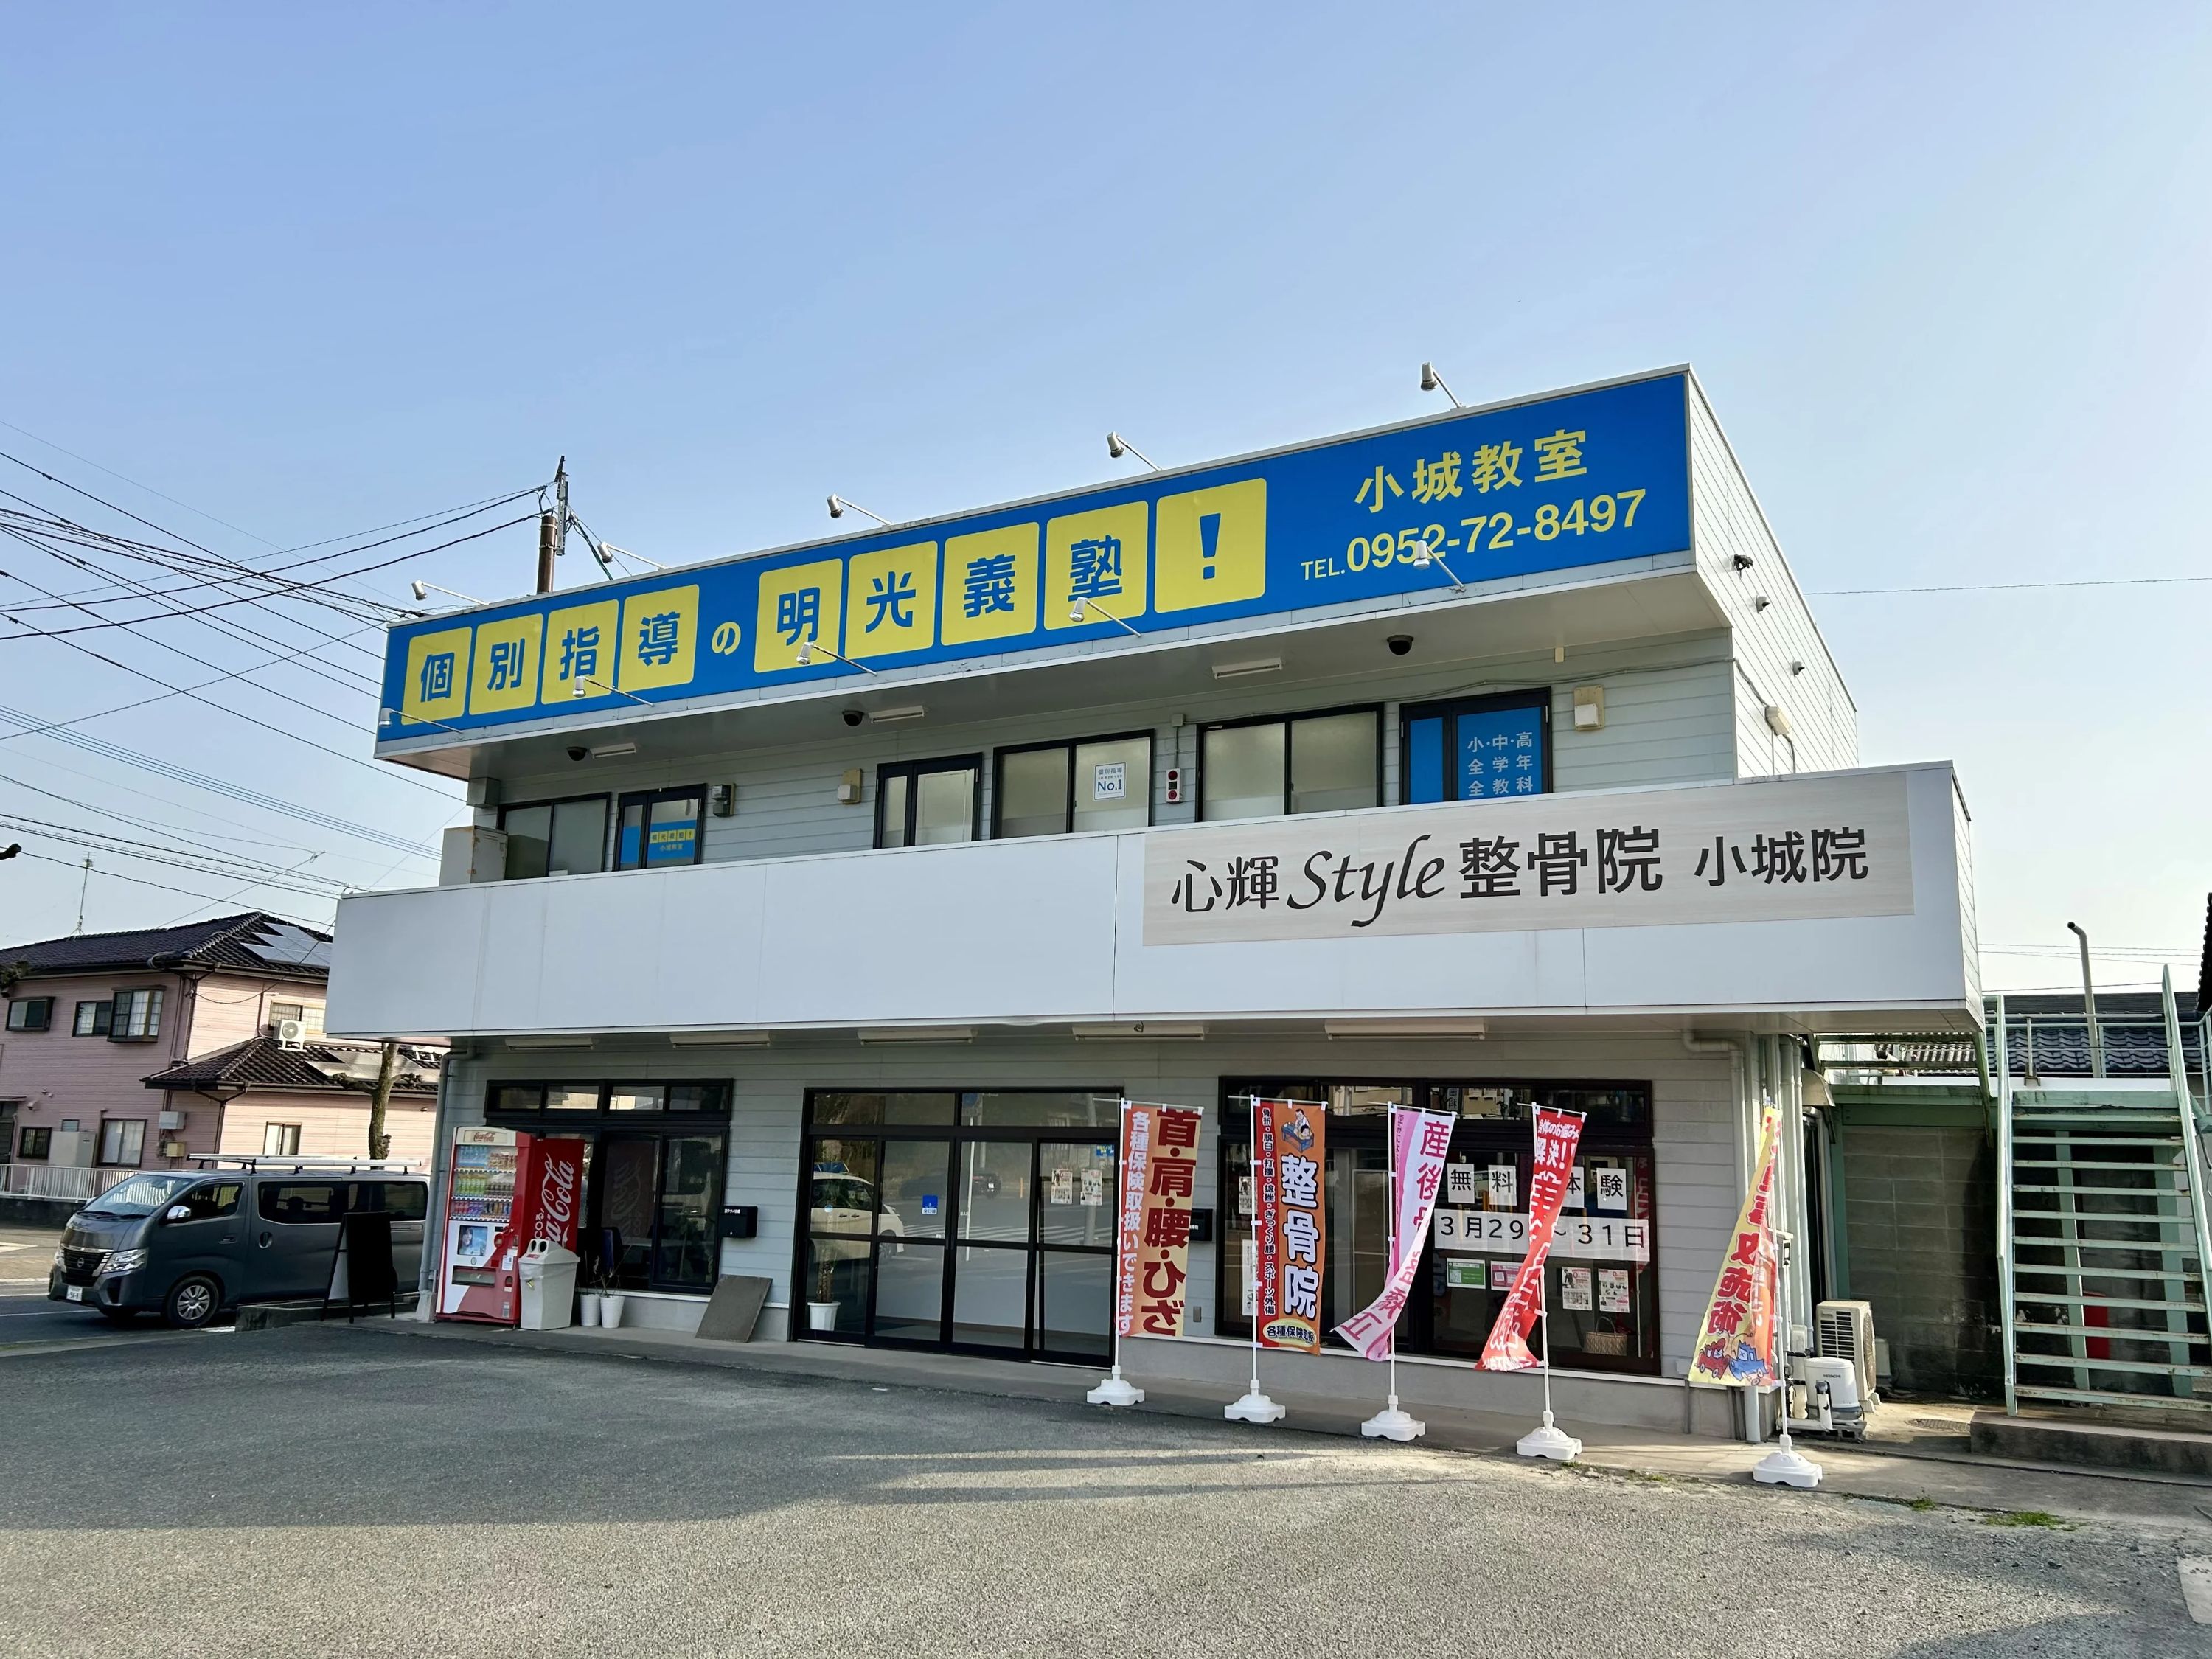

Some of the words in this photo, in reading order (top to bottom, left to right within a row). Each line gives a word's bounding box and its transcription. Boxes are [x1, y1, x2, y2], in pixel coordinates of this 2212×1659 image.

[1354, 429, 1587, 513] 小城教室
[1467, 731, 1533, 752] 小・中・高
[1468, 754, 1533, 774] 全学年
[1097, 779, 1122, 792] No.1
[1468, 776, 1534, 797] 全教科
[1171, 855, 1280, 912] 心輝
[1286, 834, 1446, 928] Style
[1458, 825, 1663, 900] 整骨院
[1694, 827, 1868, 887] 小城院
[473, 1131, 495, 1142] Coca-Cola
[1118, 1111, 1151, 1334] 各種保険取扱いできます
[1281, 1153, 1320, 1320] 整骨院
